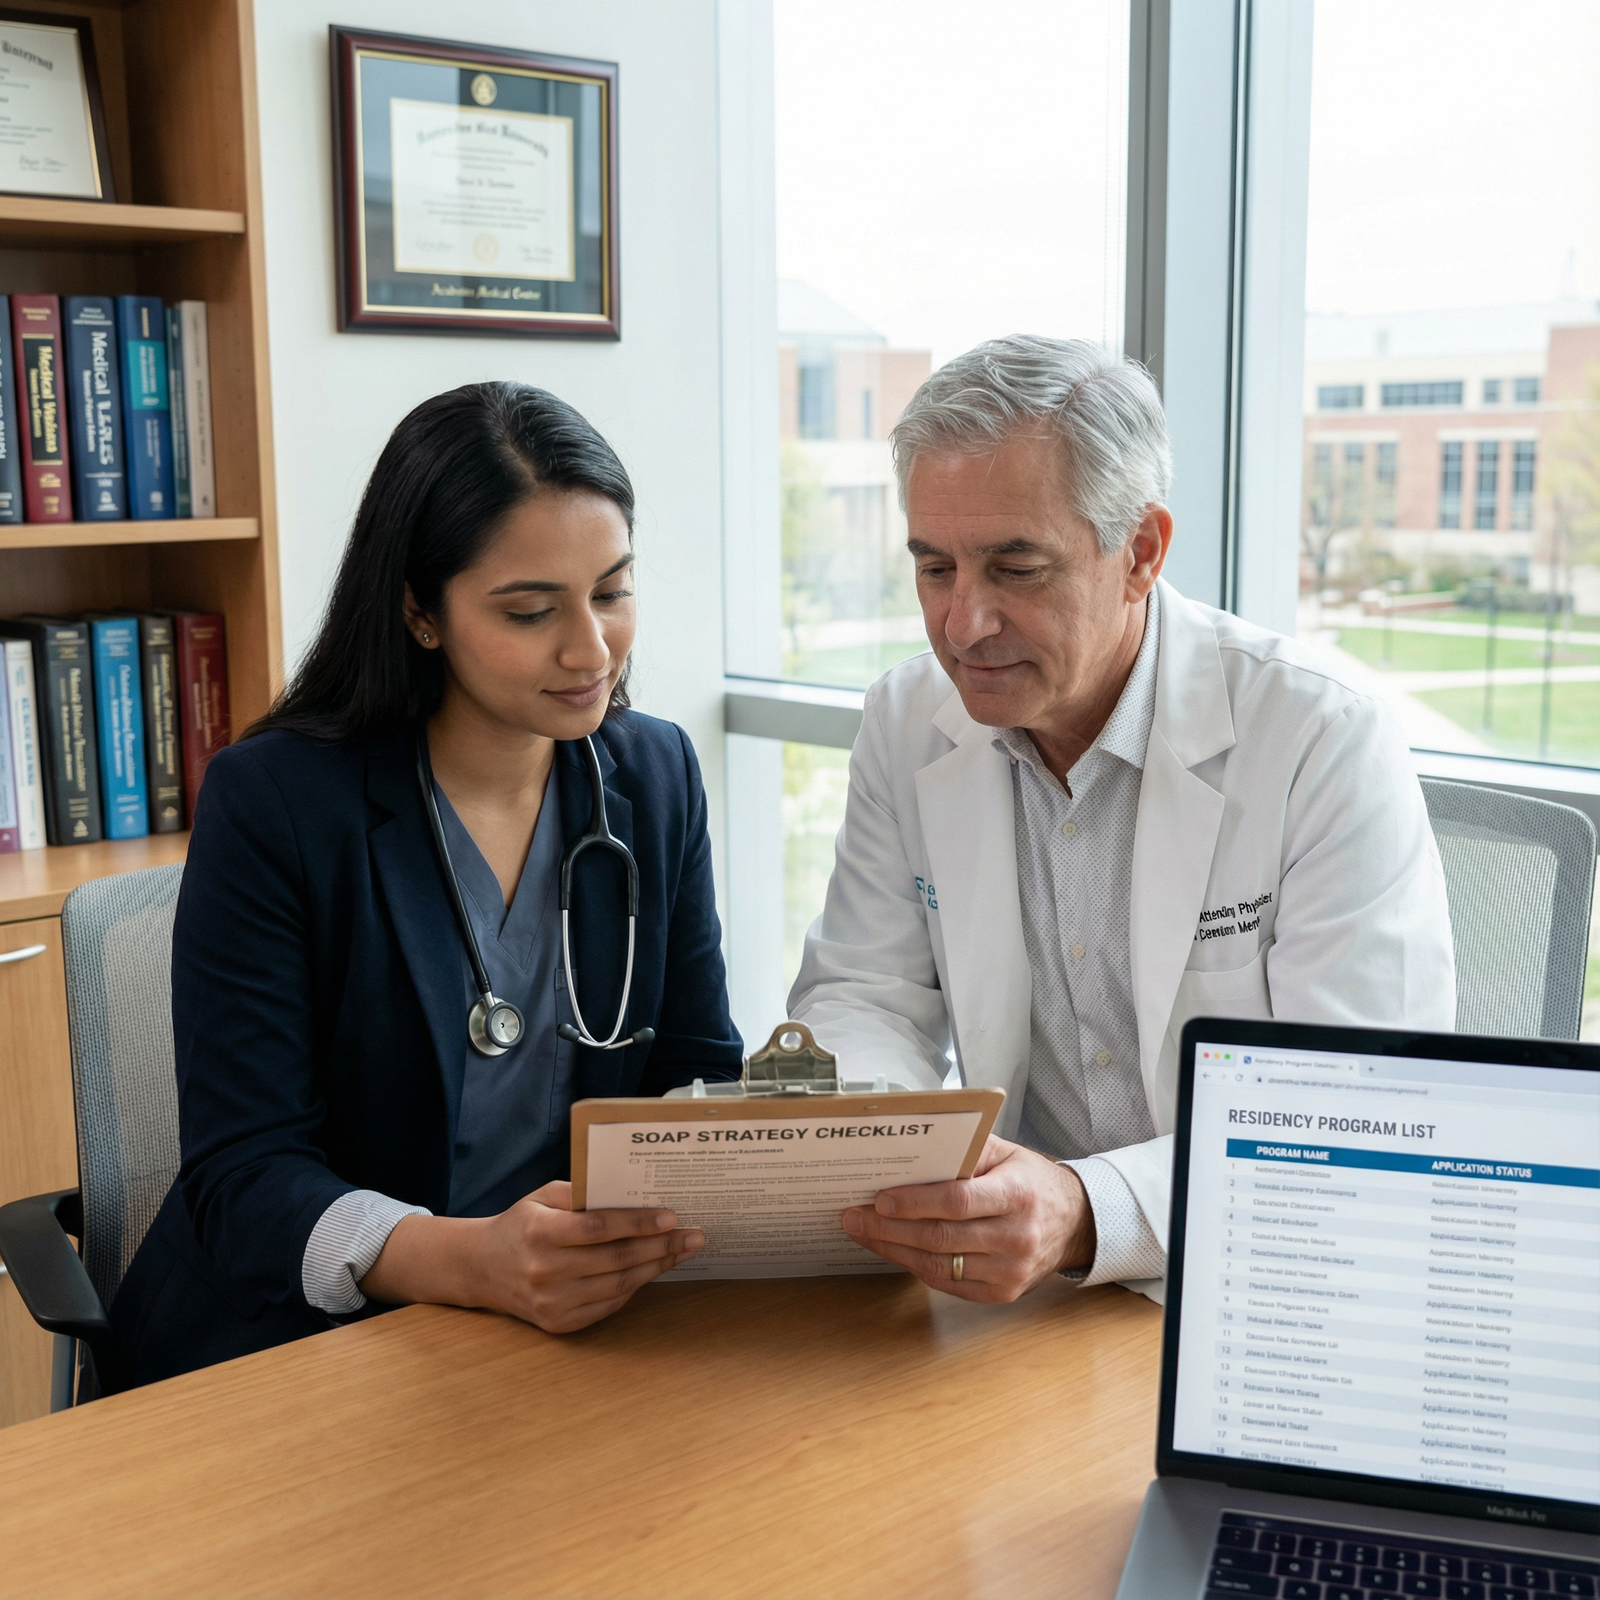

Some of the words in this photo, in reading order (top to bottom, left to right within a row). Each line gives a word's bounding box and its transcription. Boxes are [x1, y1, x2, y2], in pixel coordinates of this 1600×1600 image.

[91, 331, 111, 395] Medical
[1228, 1108, 1314, 1129] RESIDENCY
[1318, 1116, 1397, 1136] PROGRAM
[1401, 1123, 1436, 1139] LIST
[631, 1131, 690, 1144] SOAP
[697, 1127, 809, 1142] STRATEGY
[815, 1123, 935, 1139] CHECKLIST
[1256, 1145, 1301, 1159] PROGRAM
[1303, 1149, 1330, 1161] NAME
[1431, 1160, 1494, 1175] APPLICATION
[1495, 1165, 1532, 1179] STATUS
[1230, 1179, 1235, 1187] 2
[1227, 1229, 1233, 1237] 5
[1221, 1346, 1231, 1354] 12
[1219, 1396, 1228, 1404] 15
[1217, 1430, 1226, 1438] 17
